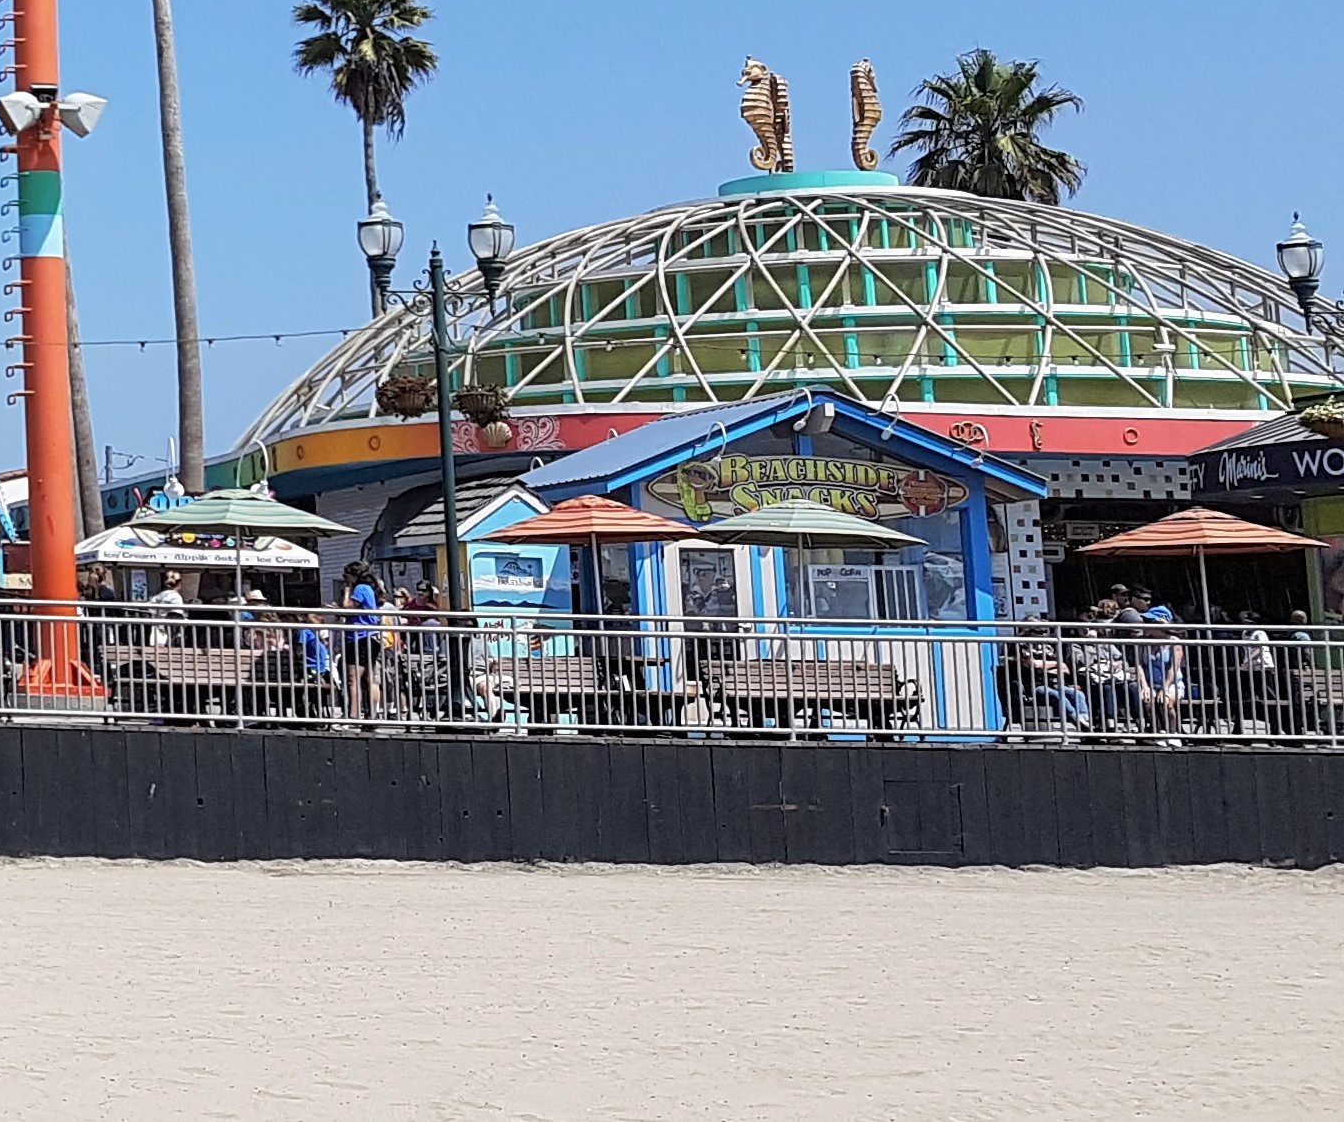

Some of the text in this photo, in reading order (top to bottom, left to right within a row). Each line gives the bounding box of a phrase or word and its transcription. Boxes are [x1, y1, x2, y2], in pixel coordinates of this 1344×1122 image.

[719, 455, 898, 492] BEACHSIDE
[1218, 450, 1280, 492] Marini's
[731, 482, 879, 518] SNACKS
[121, 551, 157, 560] Cream
[275, 556, 311, 564] Cream
